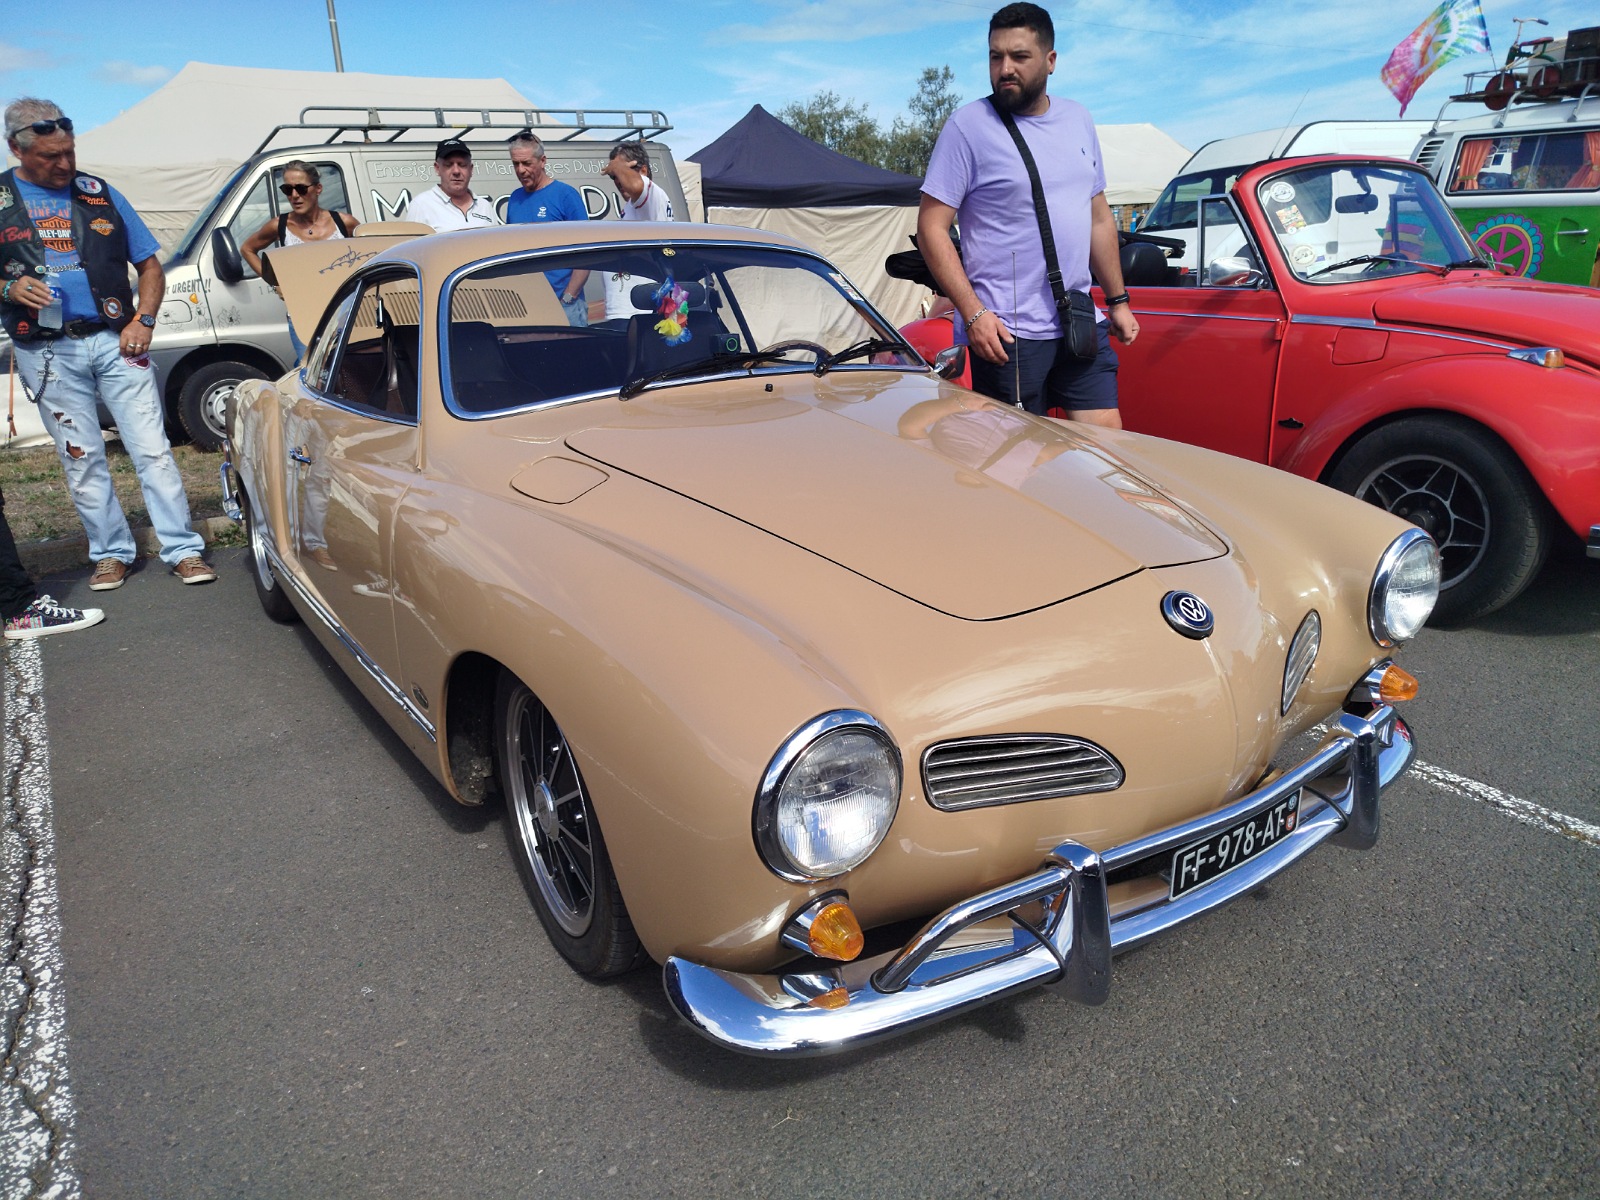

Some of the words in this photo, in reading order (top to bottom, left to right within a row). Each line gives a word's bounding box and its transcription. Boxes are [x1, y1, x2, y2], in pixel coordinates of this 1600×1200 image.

[374, 161, 436, 181] Enseign
[484, 161, 571, 179] Marges
[1034, 190, 1055, 255] REDSKINS
[171, 278, 201, 294] URGENT
[1179, 597, 1206, 621] VW
[1180, 803, 1287, 889] FF-978-AT
